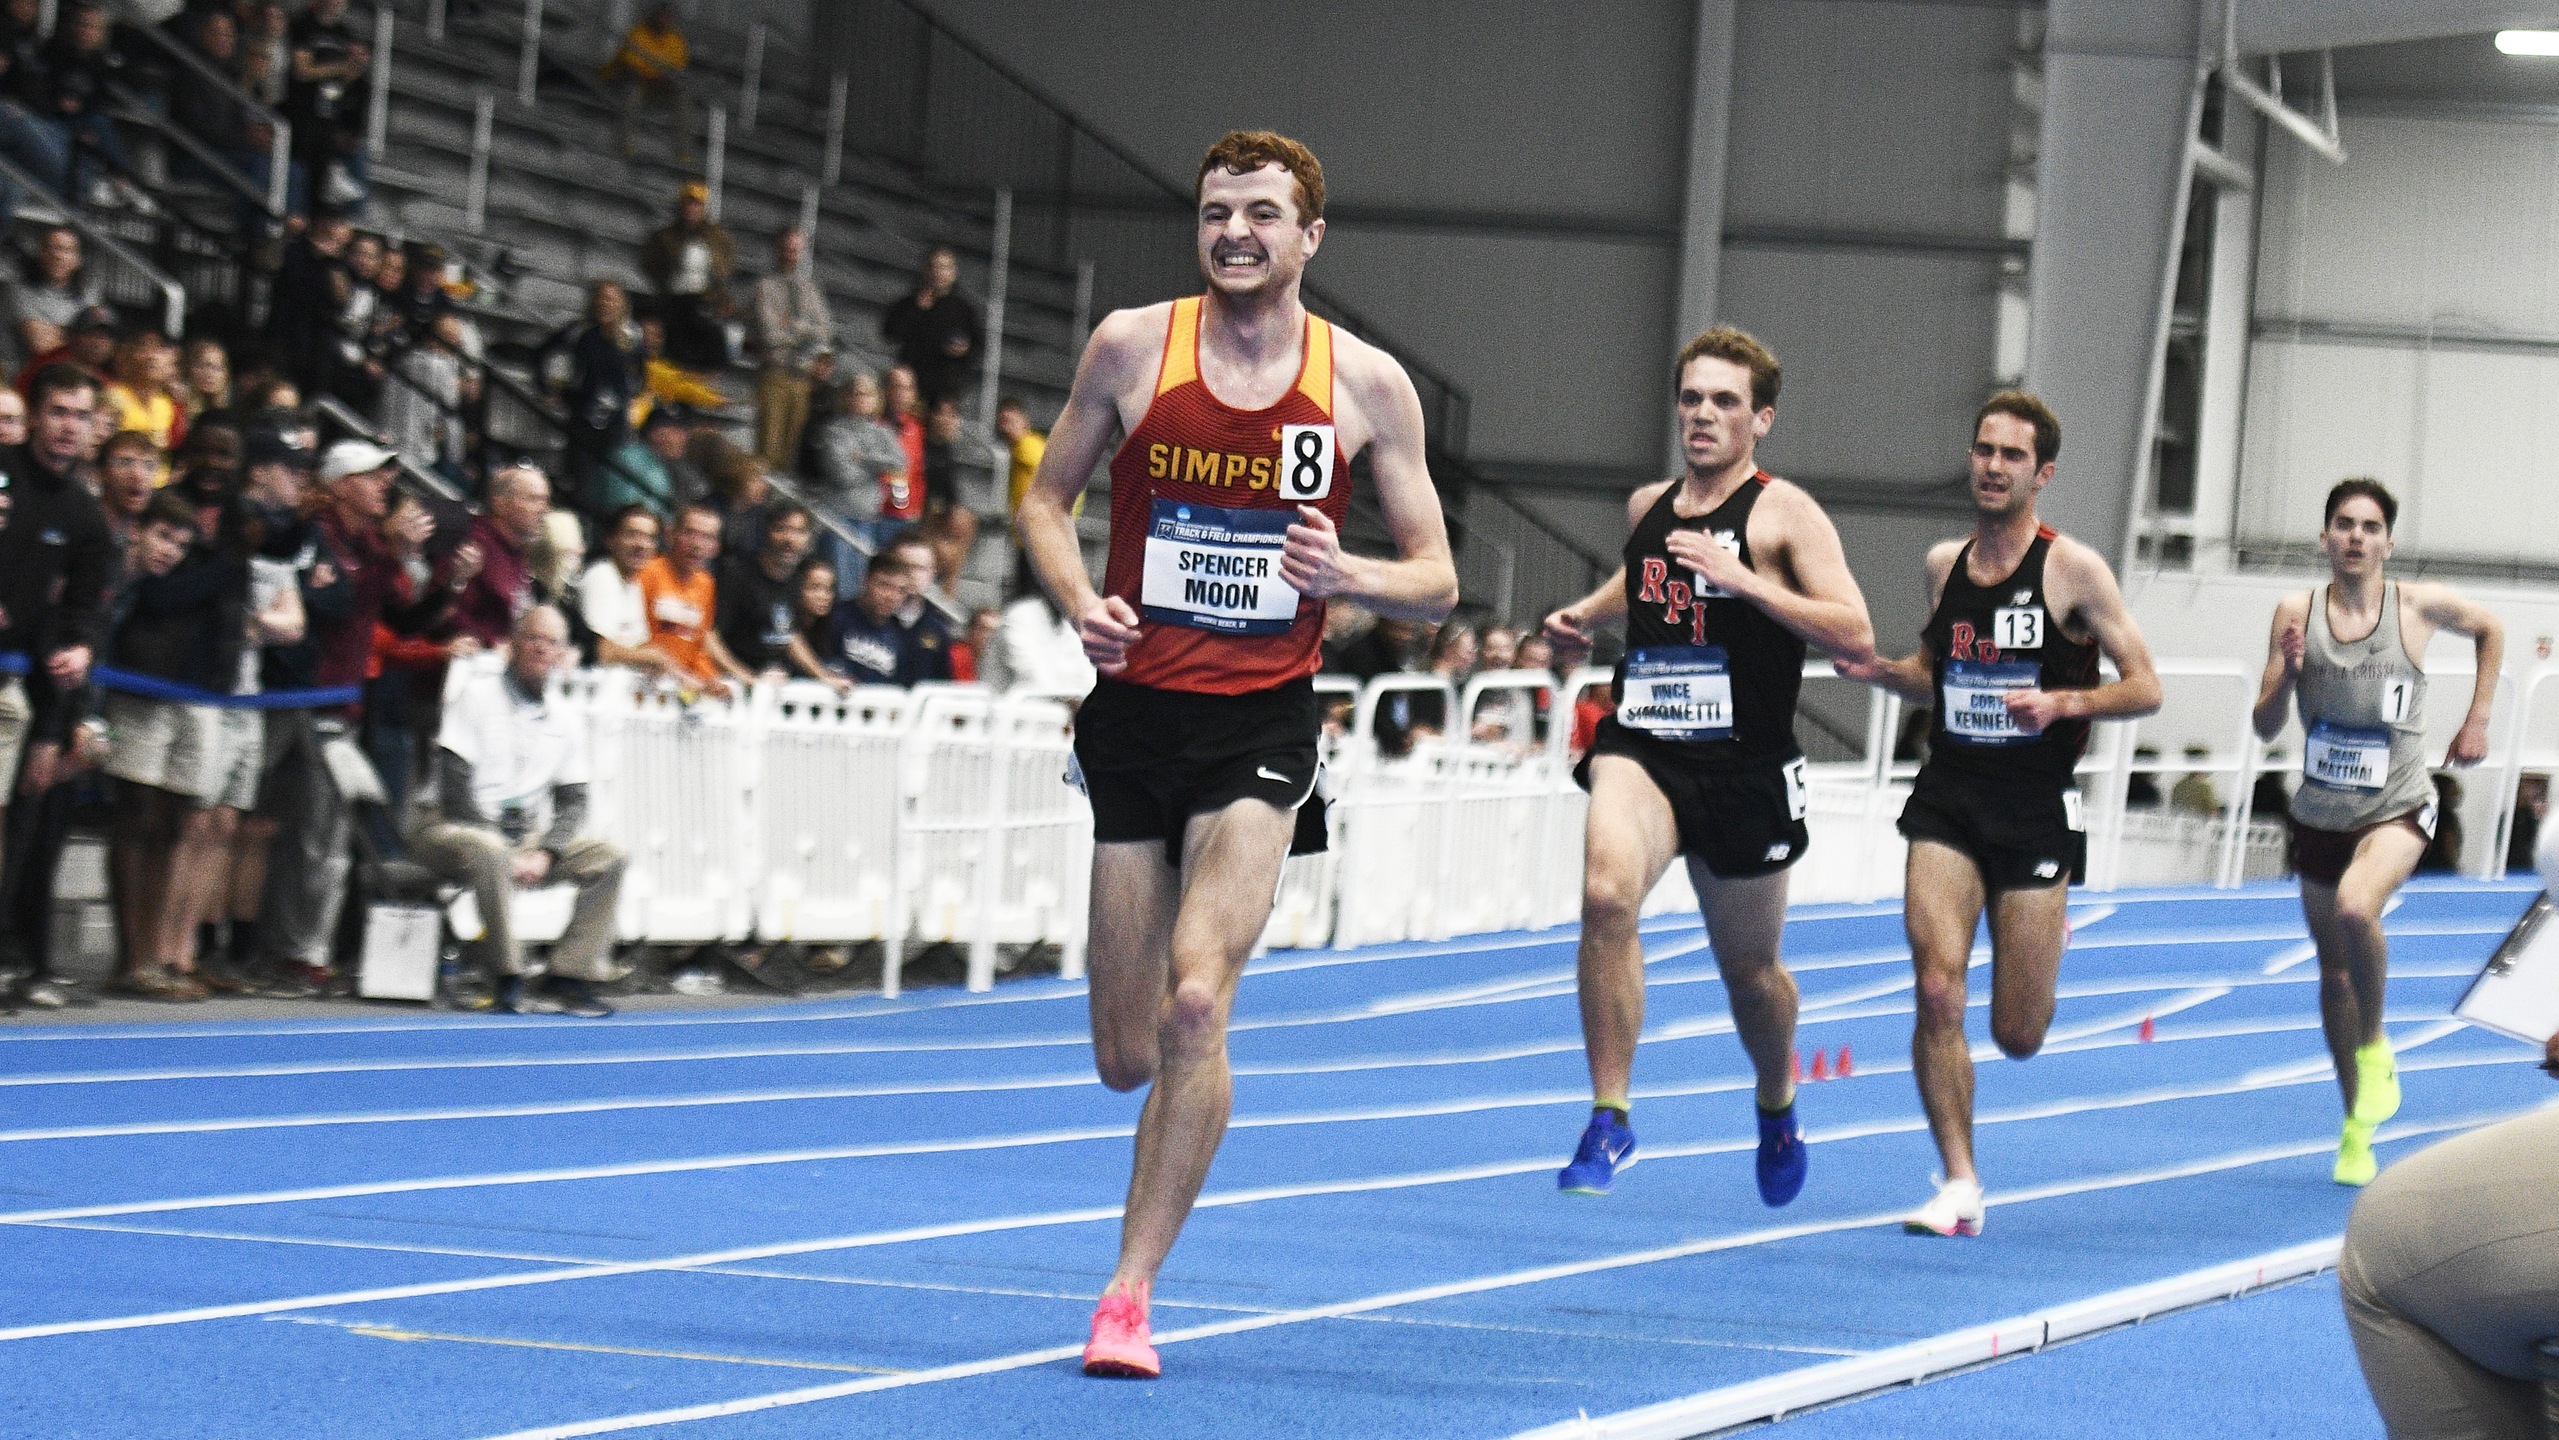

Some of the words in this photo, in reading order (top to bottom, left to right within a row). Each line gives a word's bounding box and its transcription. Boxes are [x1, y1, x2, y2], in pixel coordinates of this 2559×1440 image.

[1291, 430, 1323, 496] 8
[1174, 526, 1201, 540] TRACK
[1208, 530, 1231, 542] FIELD
[1232, 532, 1287, 545] CHAMPIONSHI
[1178, 550, 1268, 578] SPENCER
[1184, 578, 1260, 610] MOON
[2005, 613, 2036, 647] 13
[1650, 682, 1692, 701] VINCE
[2392, 684, 2404, 720] 1
[1626, 700, 1721, 722] SIMONETTI
[2317, 758, 2373, 781] MATTHAI
